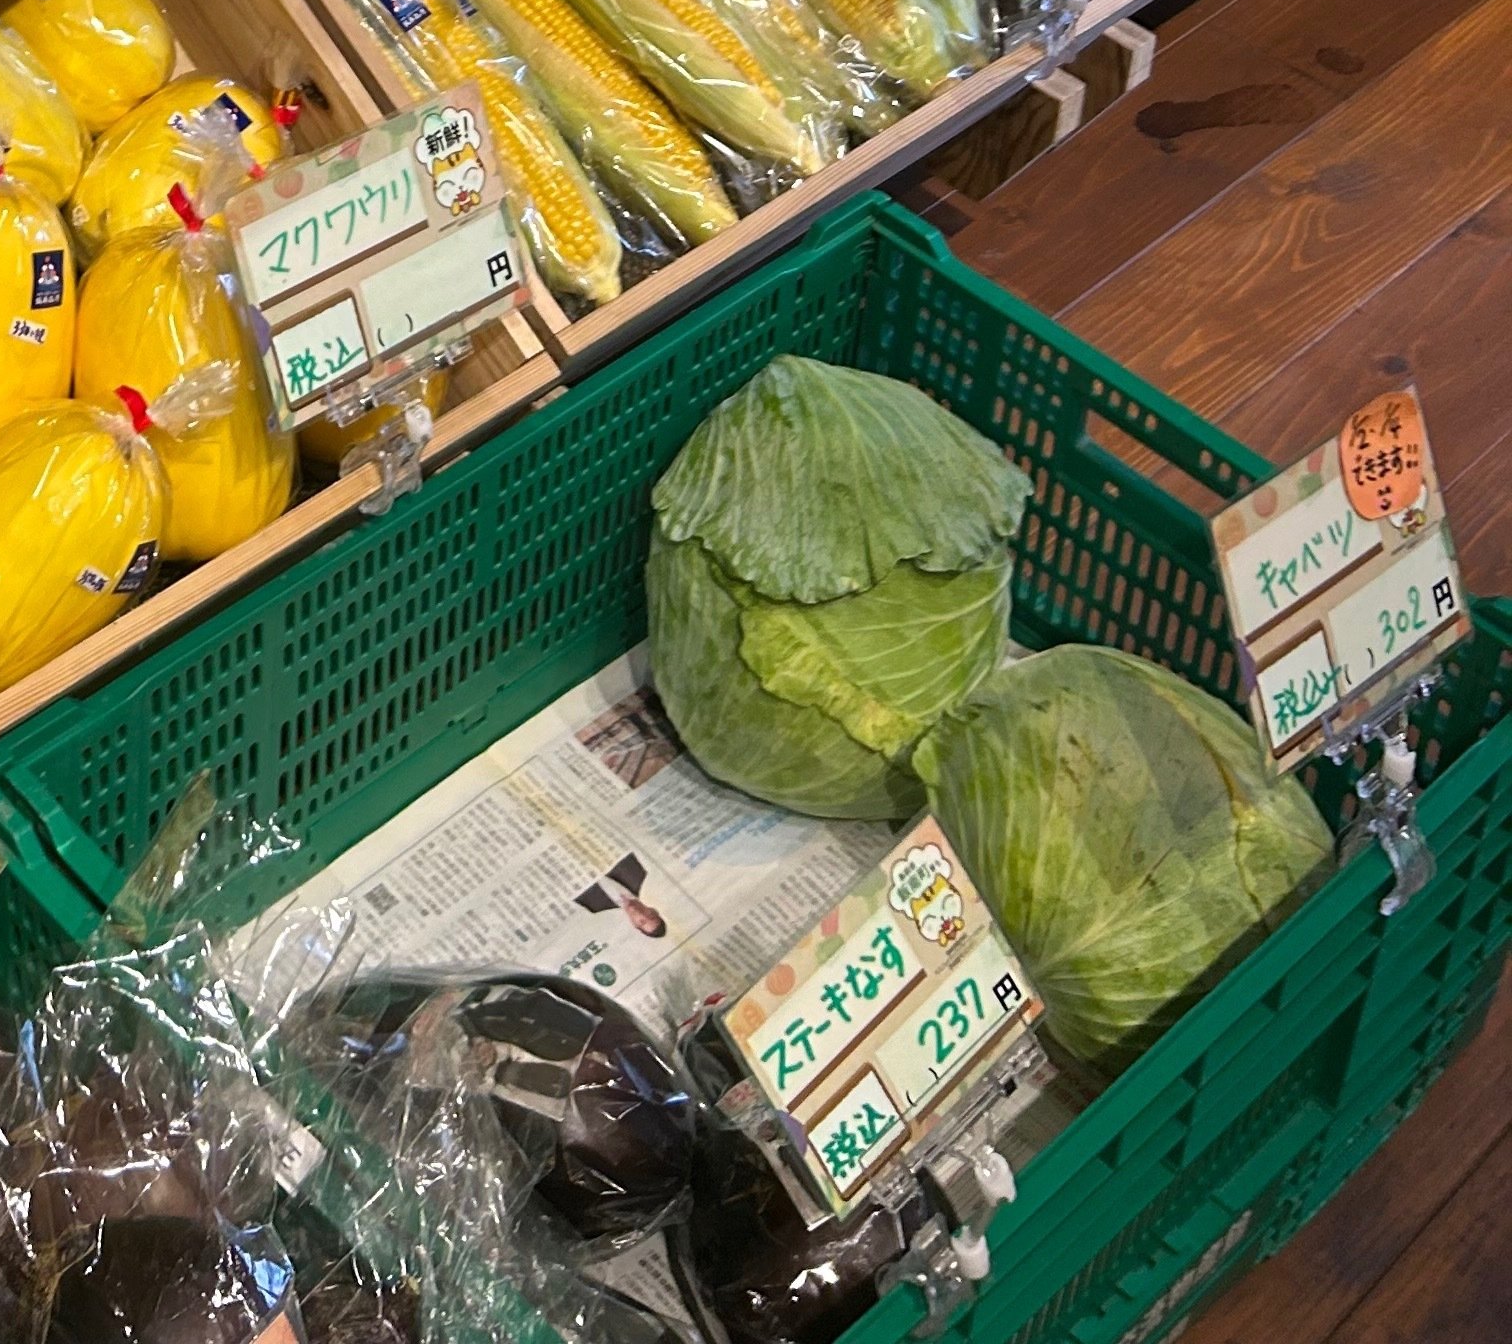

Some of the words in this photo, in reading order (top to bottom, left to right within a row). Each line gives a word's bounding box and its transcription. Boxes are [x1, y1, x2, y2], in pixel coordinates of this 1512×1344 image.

[424, 116, 469, 155] 新鮮!
[259, 168, 412, 274] マクワウリ
[487, 250, 513, 288] 円
[287, 336, 365, 396] 税込
[1256, 510, 1353, 609] キャベツ
[1379, 584, 1428, 655] 302
[1431, 576, 1454, 618] 円
[761, 924, 906, 1091] ステーキなす
[917, 976, 985, 1066] 237
[991, 972, 1022, 1013] 円
[820, 1102, 896, 1179] 税込
